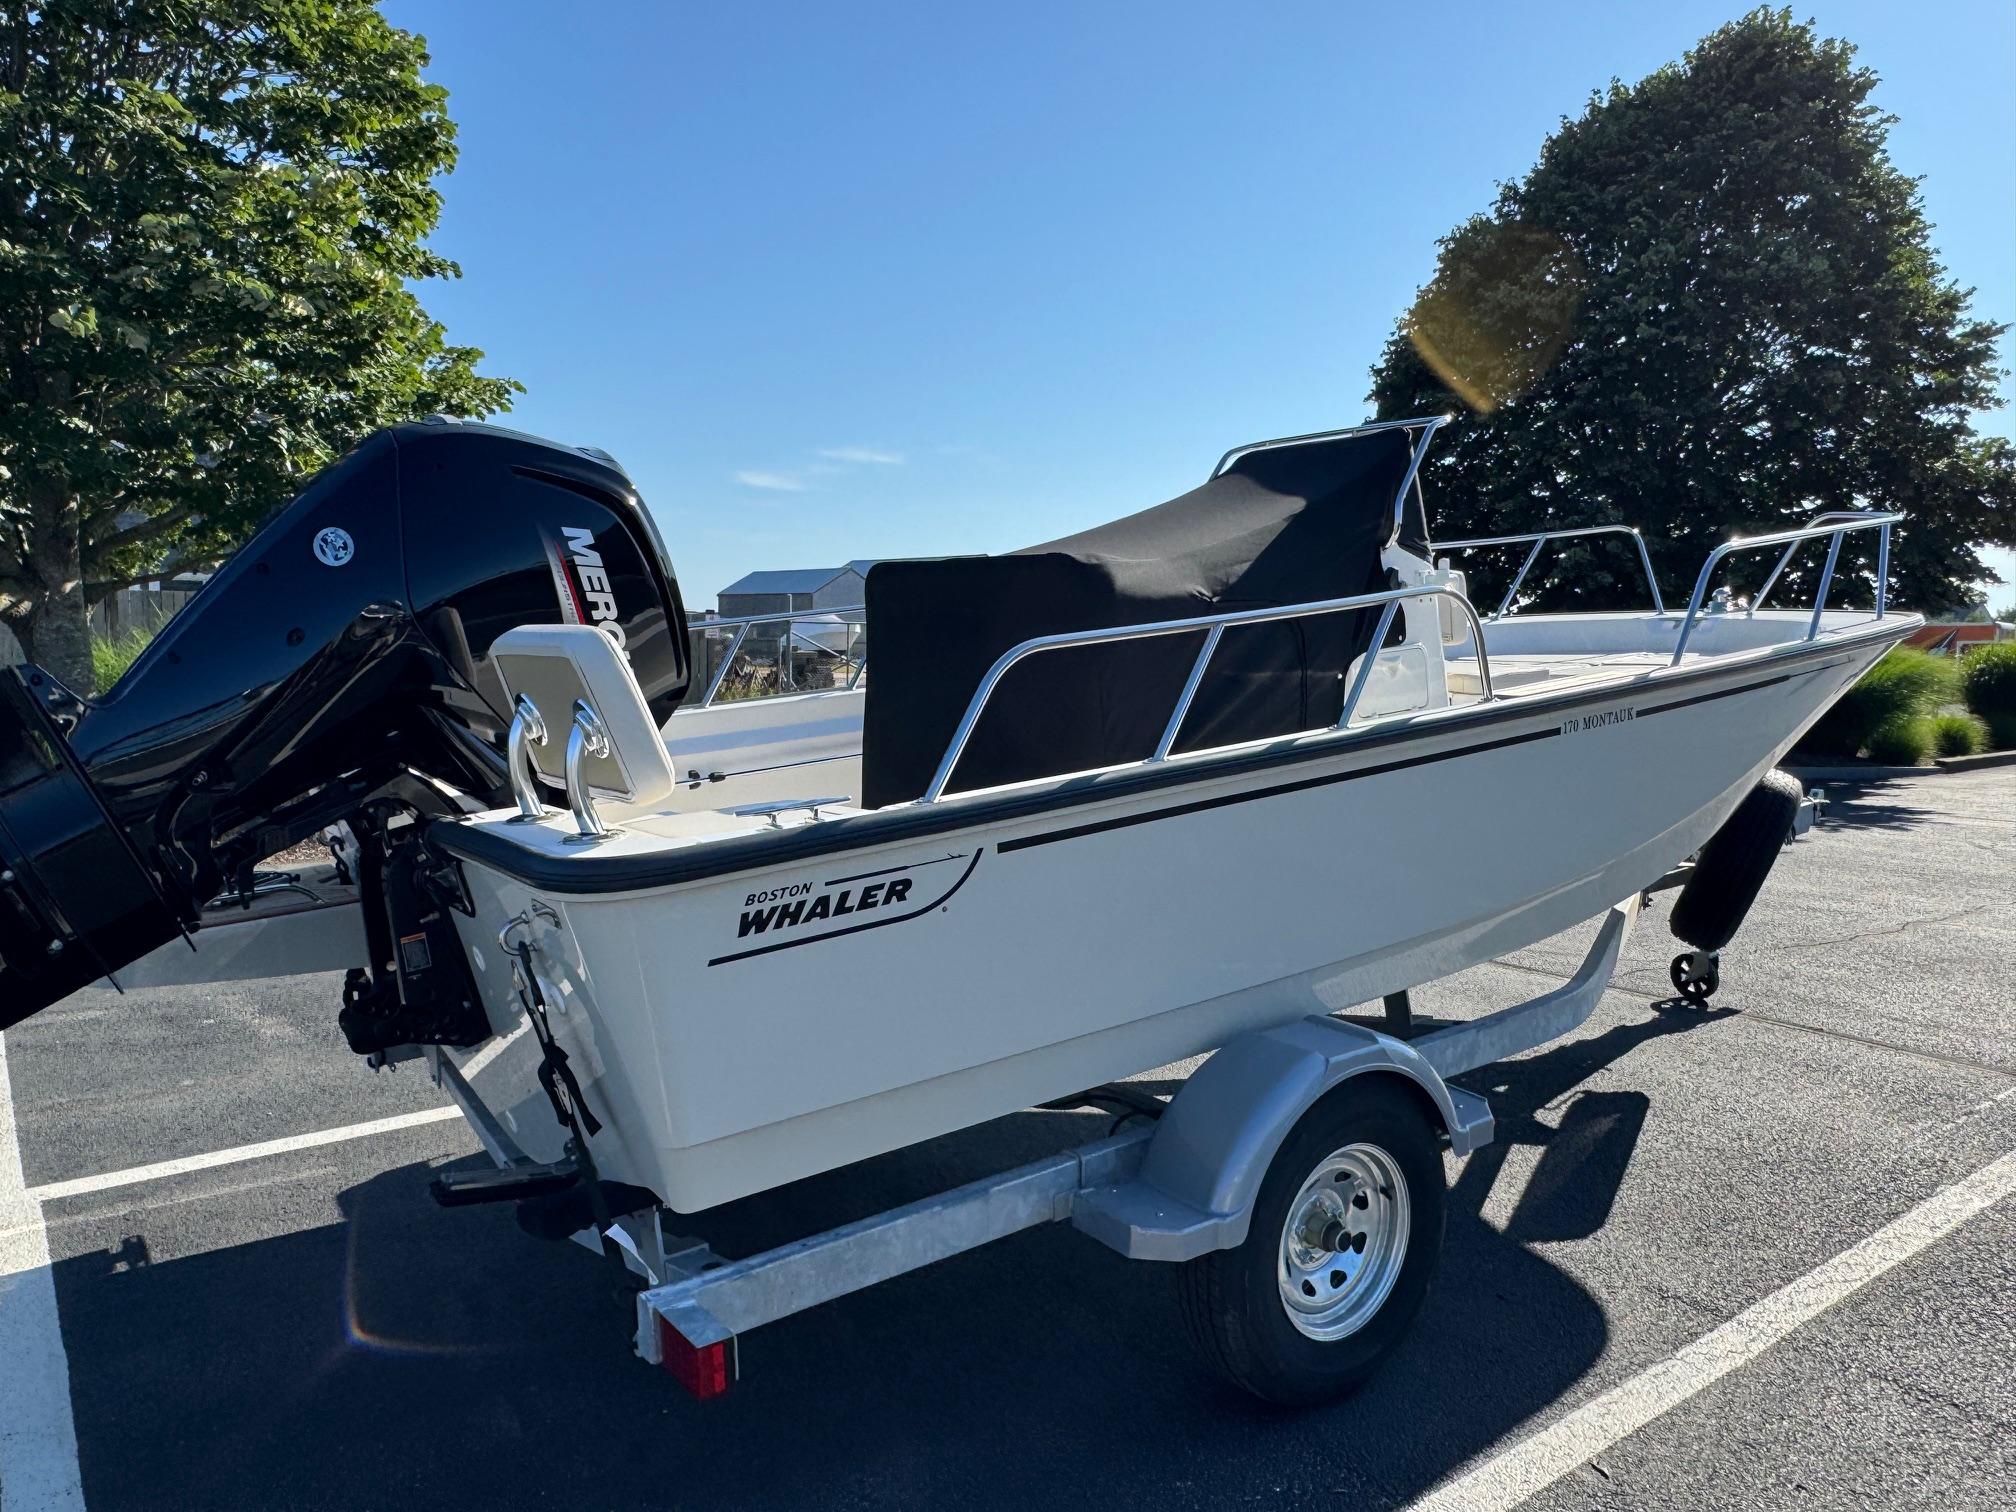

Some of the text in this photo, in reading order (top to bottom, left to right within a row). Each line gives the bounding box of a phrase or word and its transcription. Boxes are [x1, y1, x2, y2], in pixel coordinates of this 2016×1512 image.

[561, 526, 632, 660] MERC
[1563, 706, 1633, 734] 170 MONTAUK
[737, 878, 913, 938] WHALER
[745, 881, 812, 906] BOSTON
